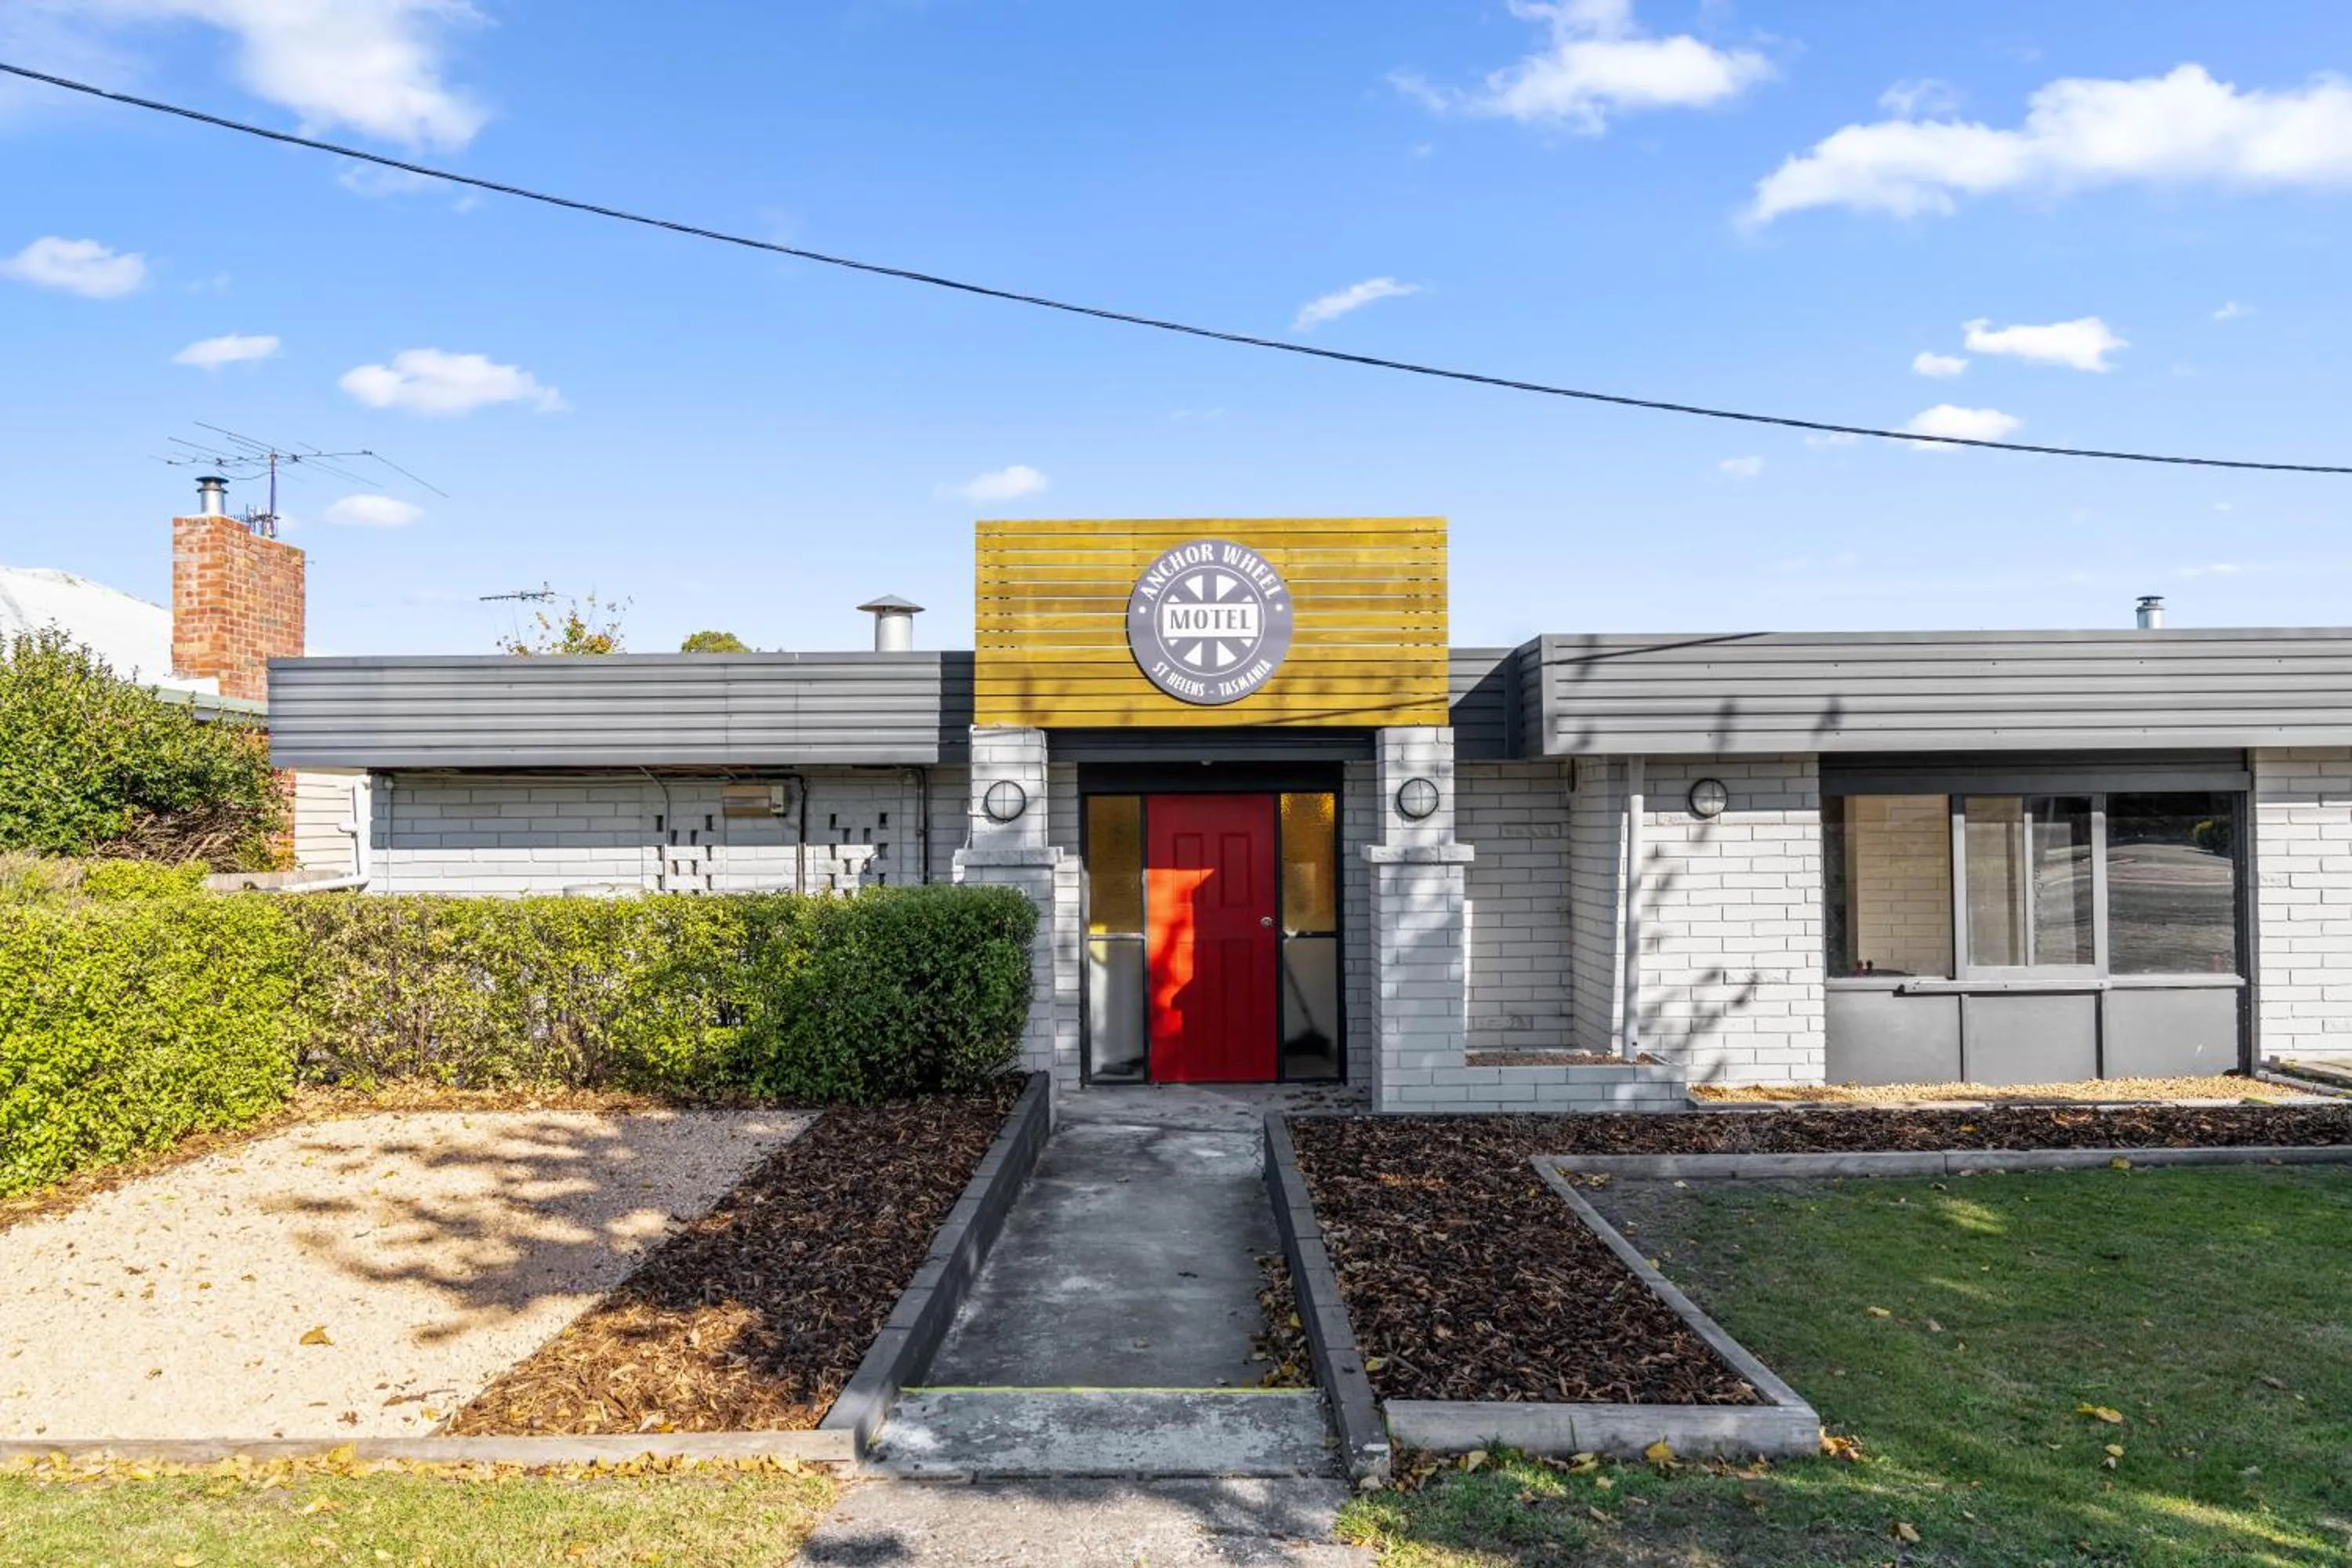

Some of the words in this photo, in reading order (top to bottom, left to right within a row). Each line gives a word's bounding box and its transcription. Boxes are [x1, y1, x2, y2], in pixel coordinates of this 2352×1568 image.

[1141, 543, 1214, 601] ANCHOR
[1222, 545, 1281, 599] WHEEL
[1171, 609, 1251, 630] MOTEL
[1152, 662, 1170, 677] ST
[1166, 672, 1205, 696] HELENS
[1218, 659, 1273, 696] TASMANIA
